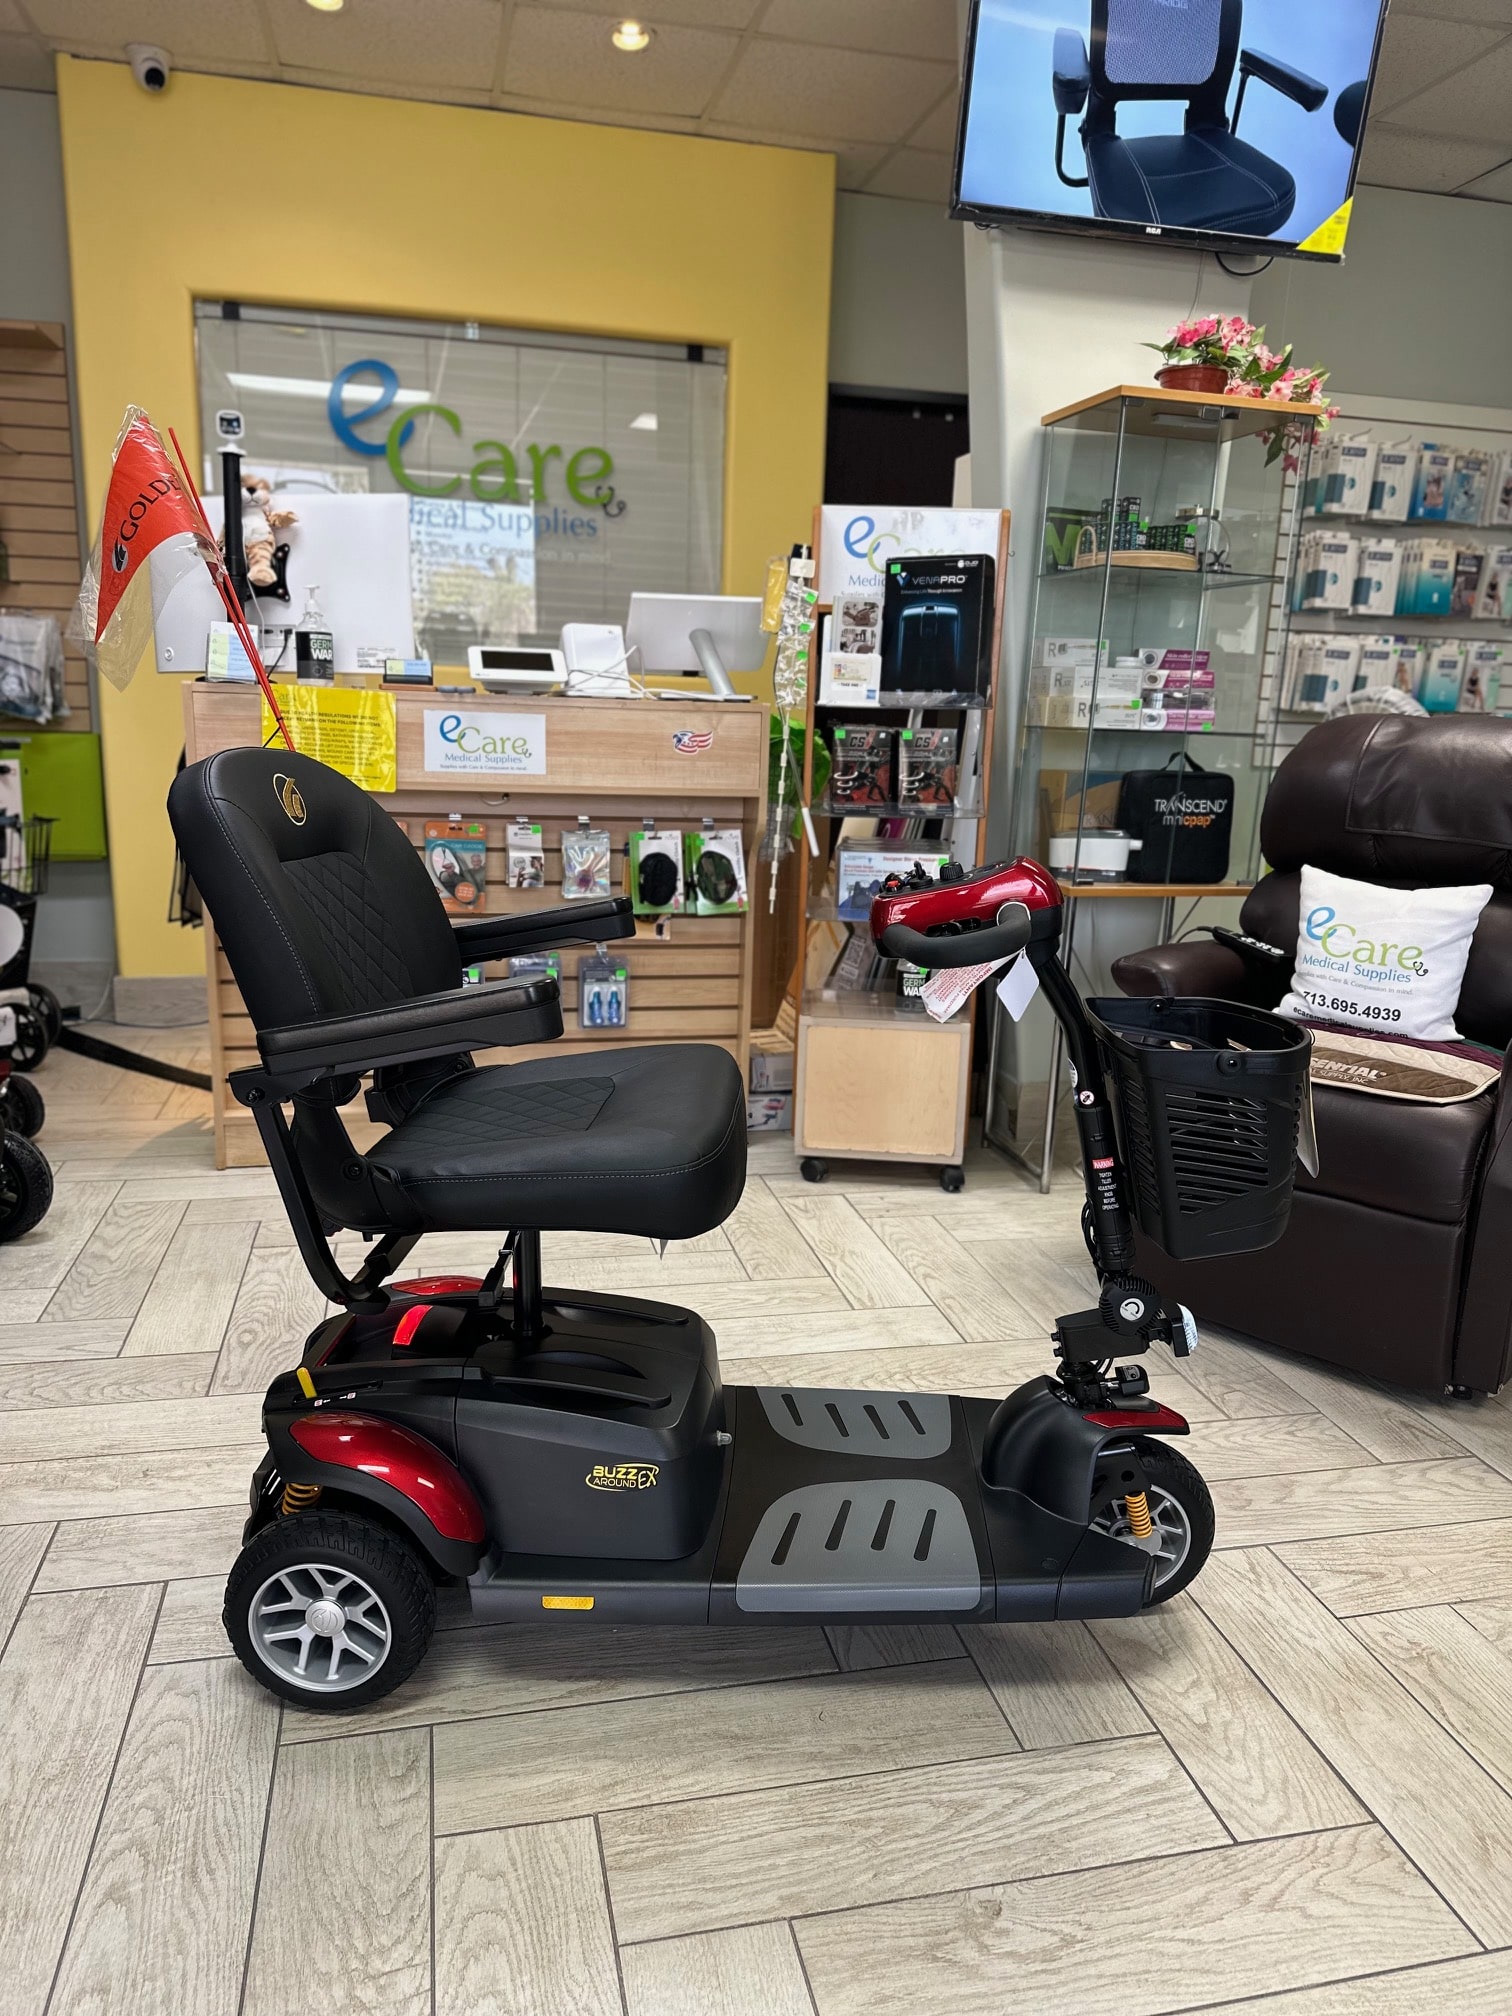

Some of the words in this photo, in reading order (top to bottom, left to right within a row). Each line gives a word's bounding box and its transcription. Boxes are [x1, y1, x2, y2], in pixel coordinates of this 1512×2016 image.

[481, 503, 598, 538] Supplies
[849, 574, 886, 587] Medic
[912, 575, 966, 585] VENAPRO
[439, 715, 527, 756] eCare
[445, 753, 481, 763] Medical
[485, 754, 522, 765] Supplies
[1306, 906, 1423, 972] eCare
[1302, 954, 1350, 973] Medical
[1353, 964, 1412, 984] Supplies
[1303, 991, 1402, 1022] 713.695.4939
[593, 1465, 637, 1480] BUZZ
[638, 1468, 657, 1489] EX
[593, 1478, 636, 1488] AROUND
